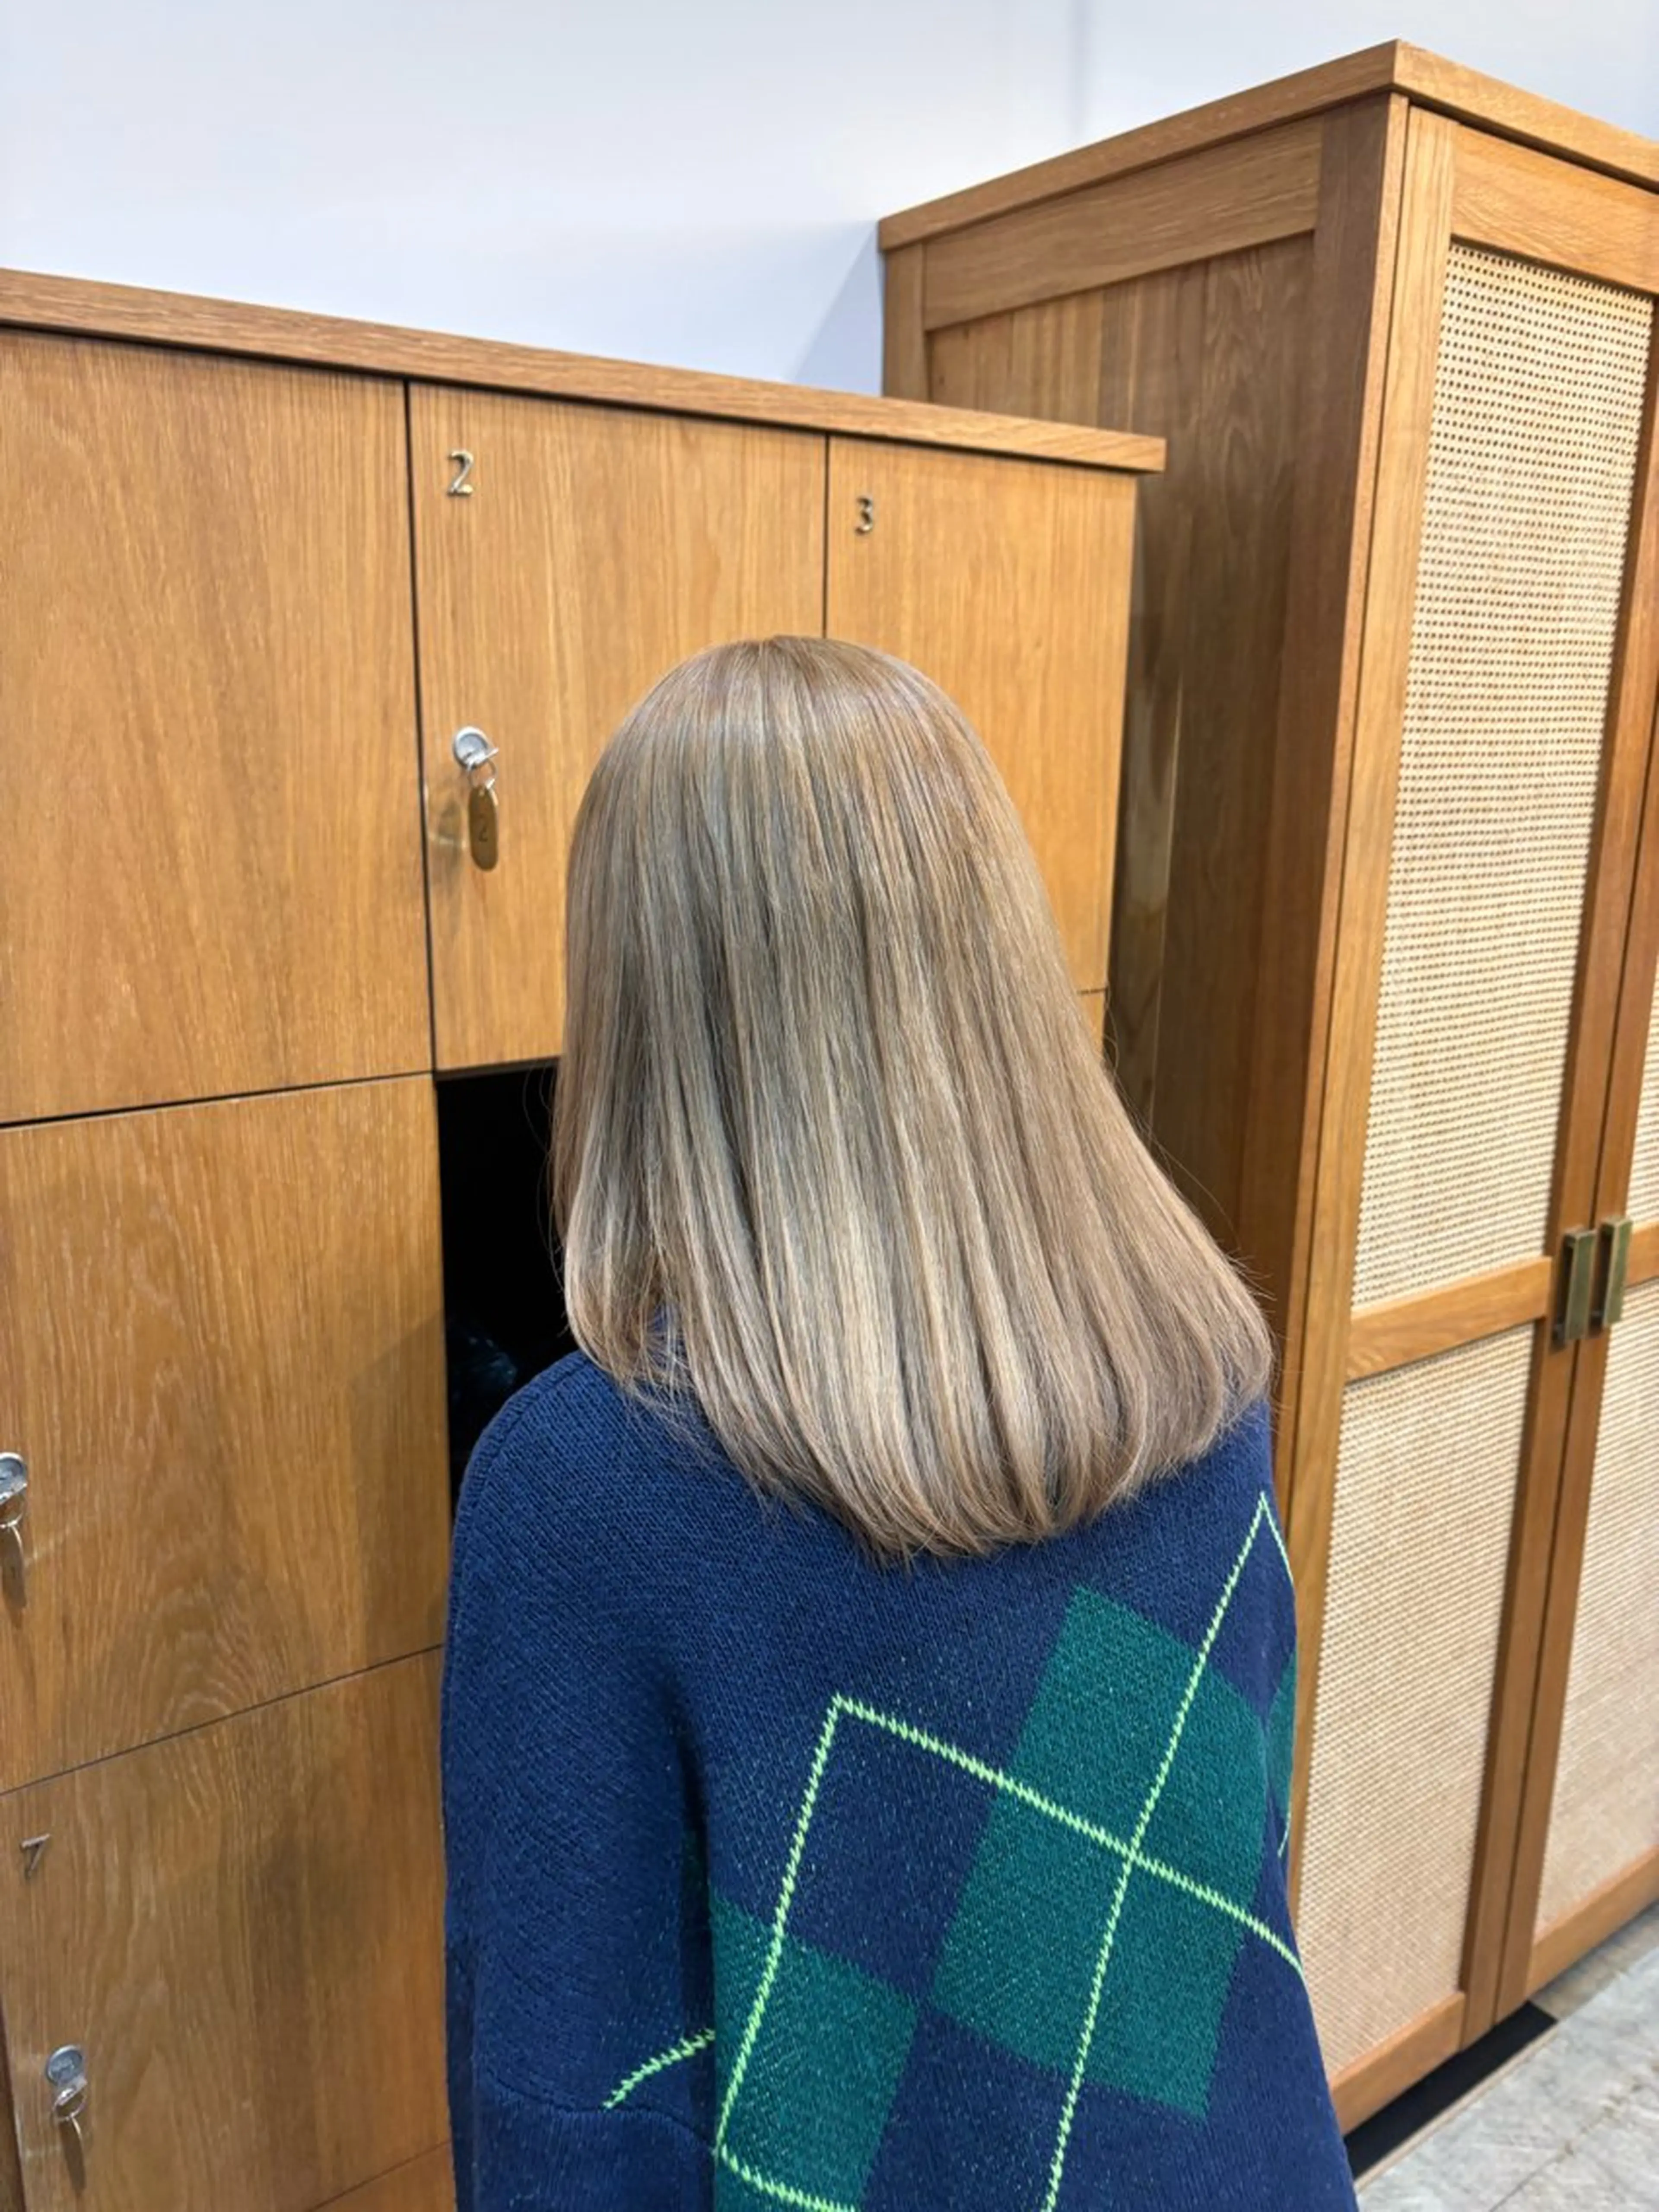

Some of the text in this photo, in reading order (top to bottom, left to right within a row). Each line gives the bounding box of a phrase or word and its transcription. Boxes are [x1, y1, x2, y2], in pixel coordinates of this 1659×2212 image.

[448, 450, 474, 496] 2
[855, 494, 873, 536] 3
[20, 1833, 50, 1880] 7
